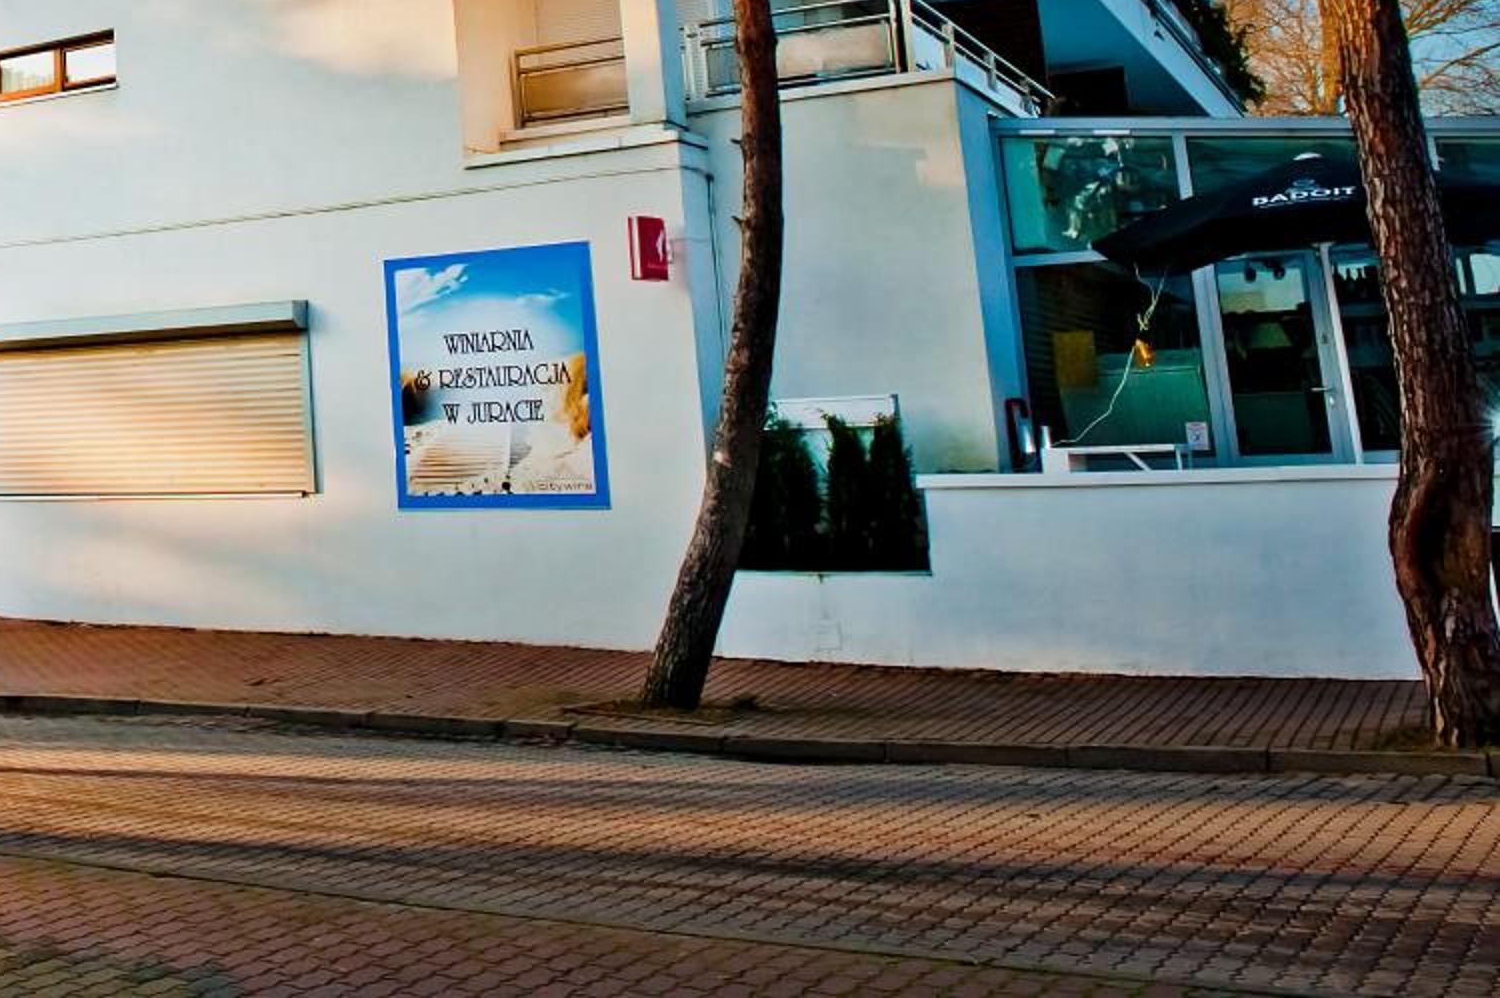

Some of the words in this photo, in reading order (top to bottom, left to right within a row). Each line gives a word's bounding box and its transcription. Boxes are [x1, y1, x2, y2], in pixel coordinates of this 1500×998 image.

[443, 329, 534, 354] WINIARNIA
[414, 369, 432, 390] &
[439, 362, 571, 389] RESTAURACJA
[443, 403, 460, 424] W
[467, 399, 545, 424] JURACIE
